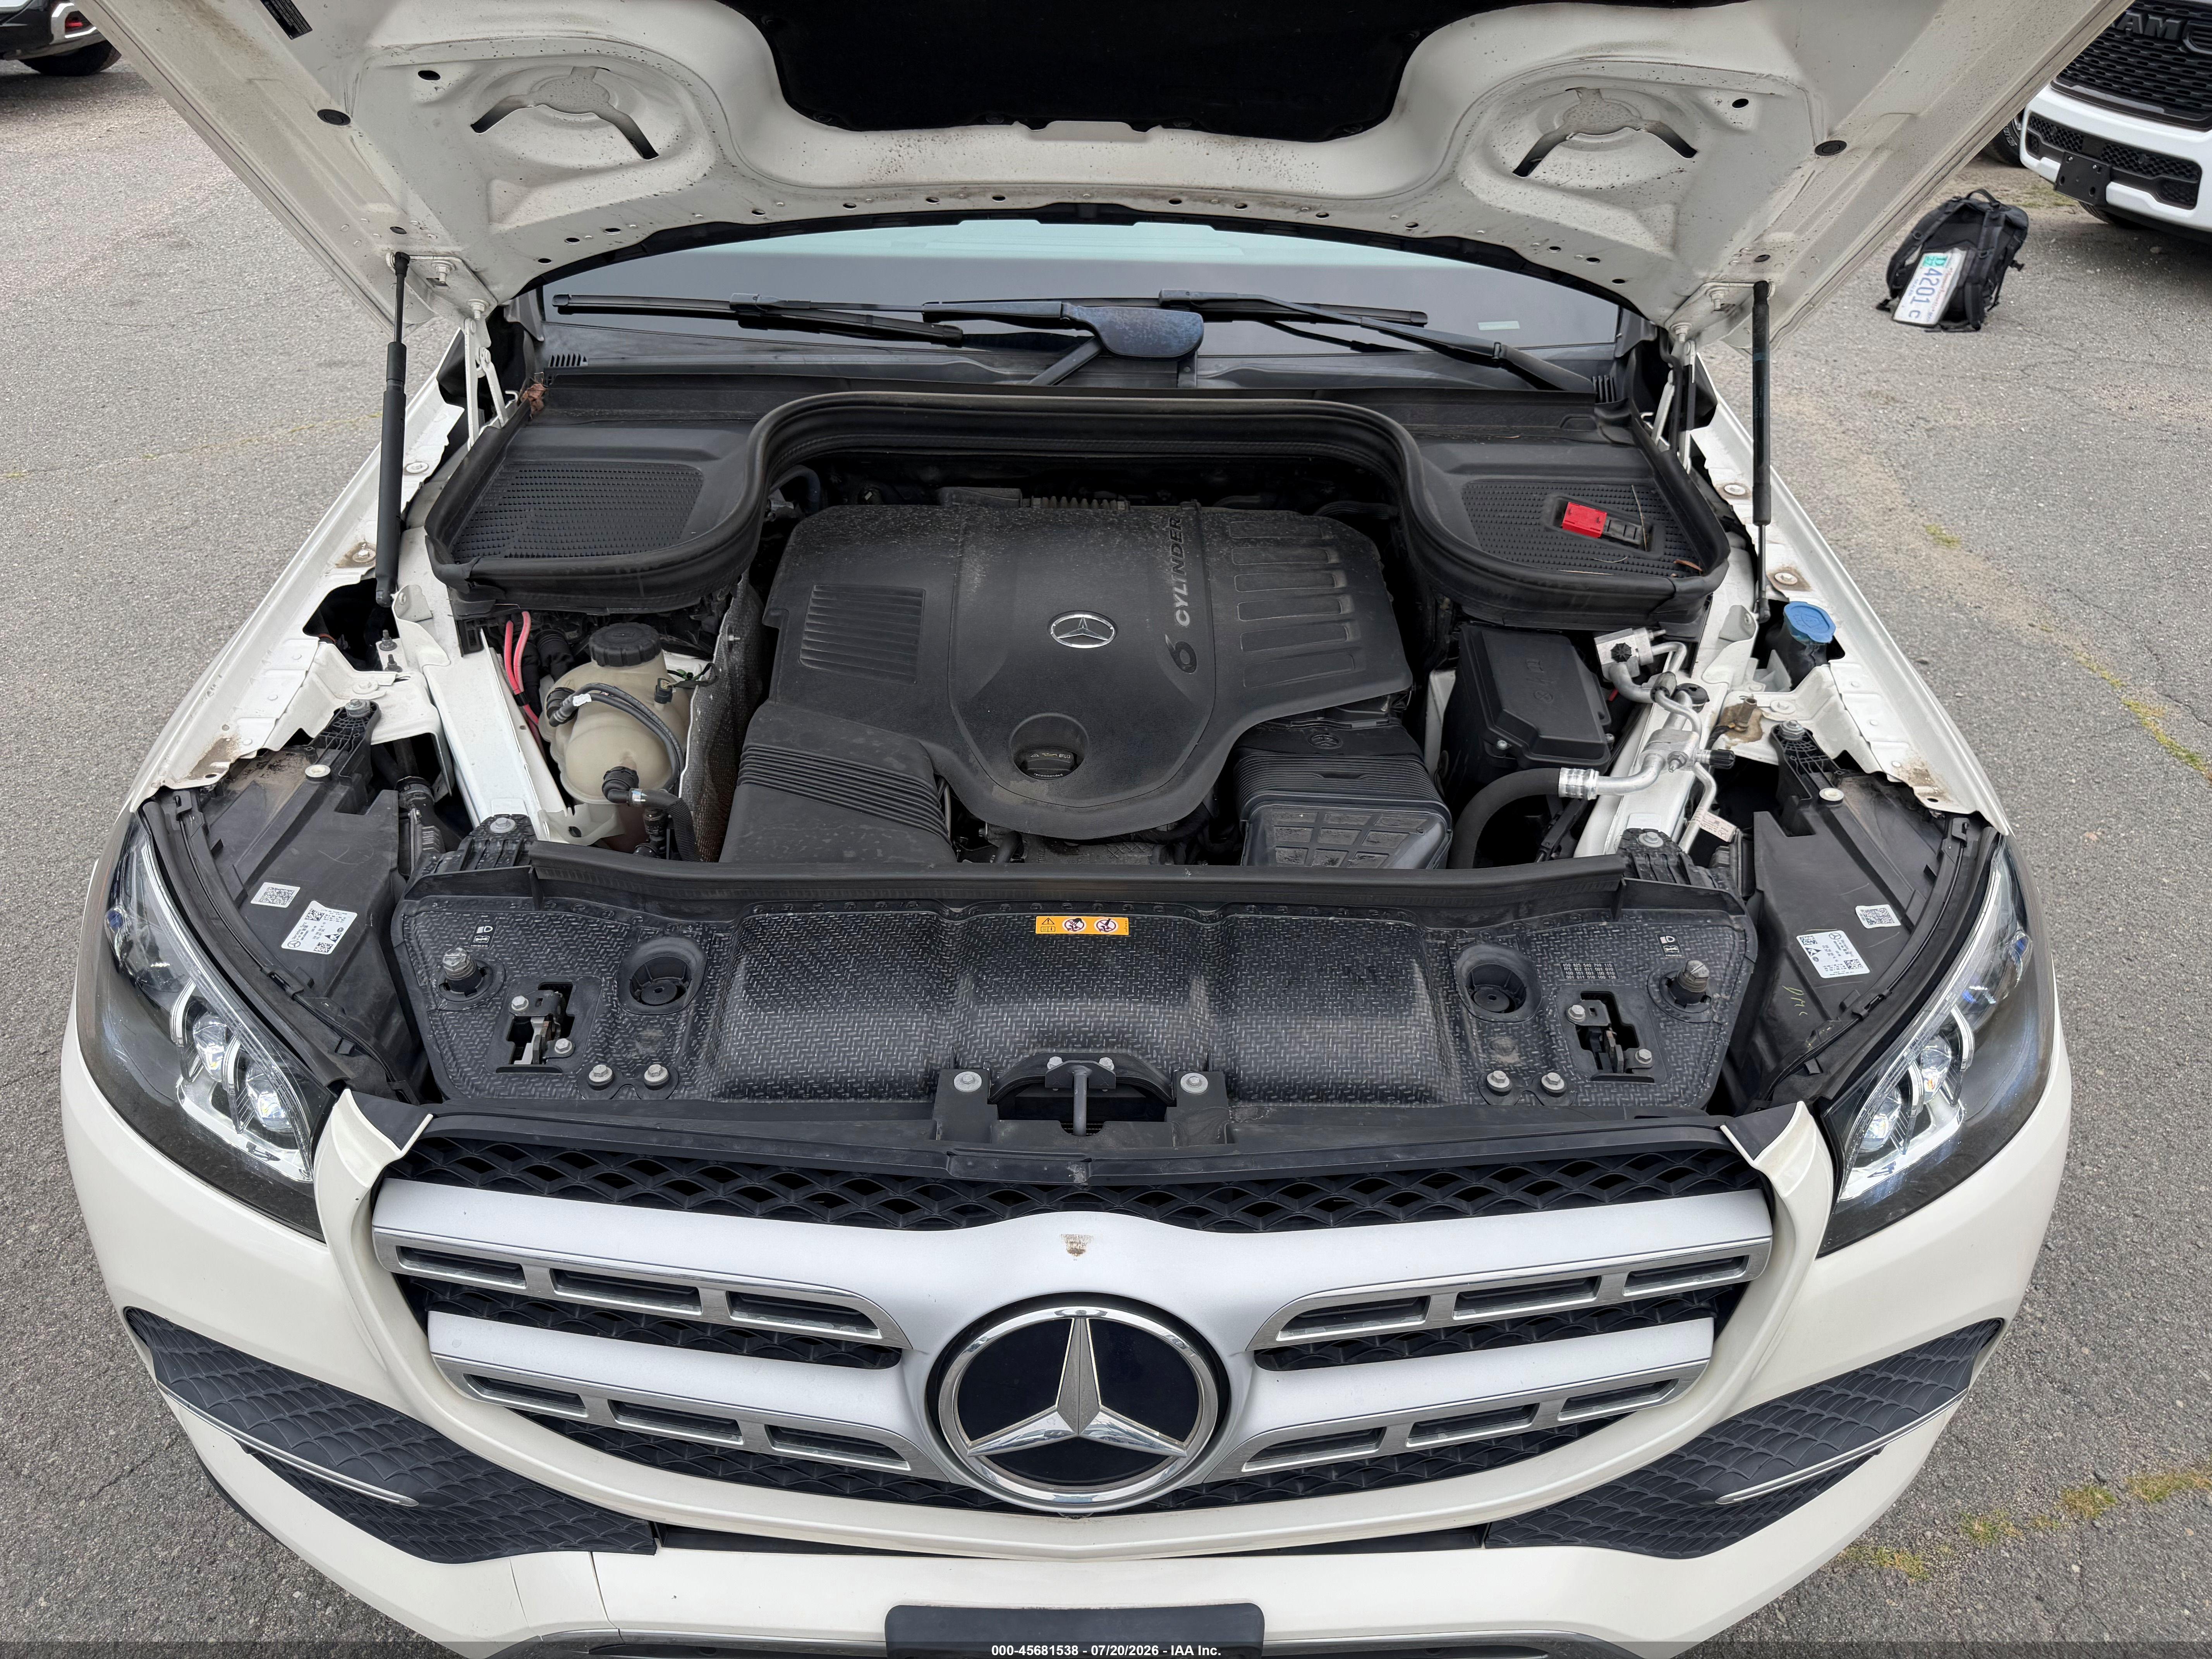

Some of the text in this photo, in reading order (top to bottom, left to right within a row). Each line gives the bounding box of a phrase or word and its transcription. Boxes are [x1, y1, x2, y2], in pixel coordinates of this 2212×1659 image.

[2112, 12, 2182, 40] AM
[1910, 268, 1943, 304] 4201
[1909, 310, 1921, 318] C
[1165, 517, 1197, 674] 6 CYLINDER
